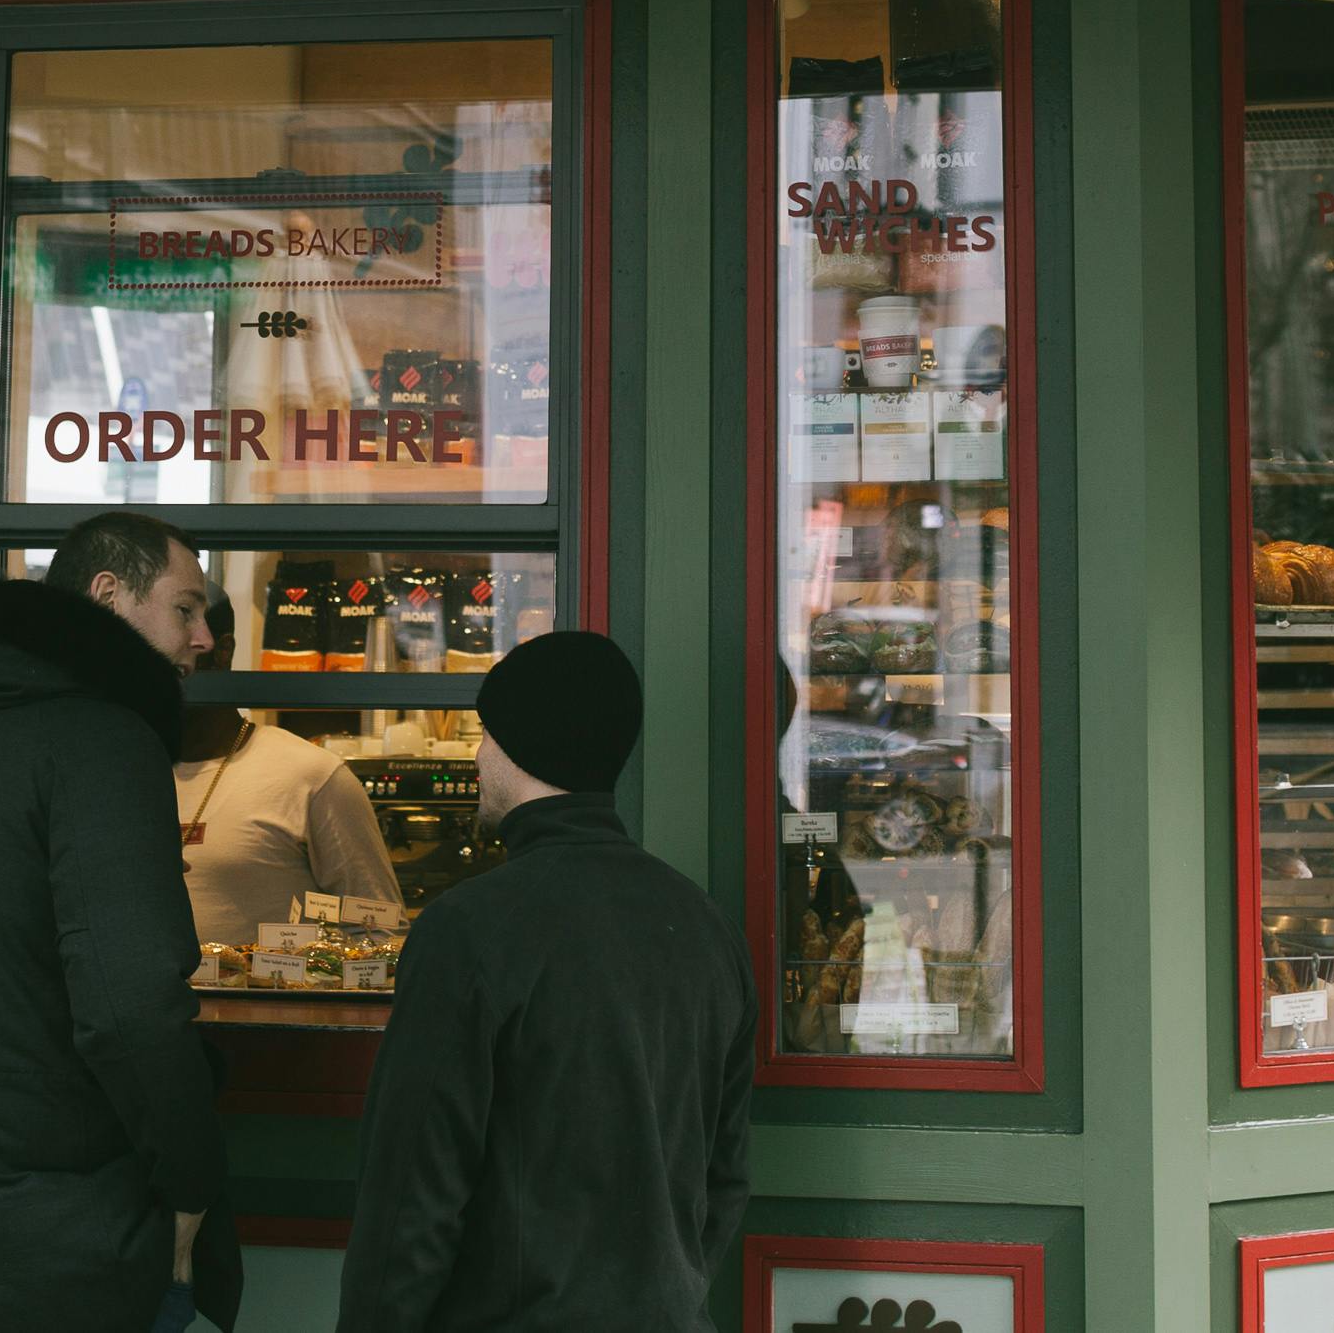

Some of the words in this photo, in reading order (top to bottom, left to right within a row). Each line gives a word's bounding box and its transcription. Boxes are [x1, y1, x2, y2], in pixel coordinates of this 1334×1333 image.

[814, 155, 873, 172] MOAK
[921, 152, 977, 169] MOAK
[787, 179, 919, 218] SAND
[814, 215, 996, 255] WICHES
[138, 229, 275, 259] BREADS
[287, 227, 413, 257] BAKERY
[392, 393, 428, 404] MOAK
[521, 388, 549, 400] MOA
[44, 408, 270, 464] ORDER
[294, 408, 464, 464] HERE
[278, 604, 315, 617] MOAK
[340, 605, 376, 617] MOAK
[400, 611, 436, 623] MOAK
[462, 605, 498, 617] MOAK
